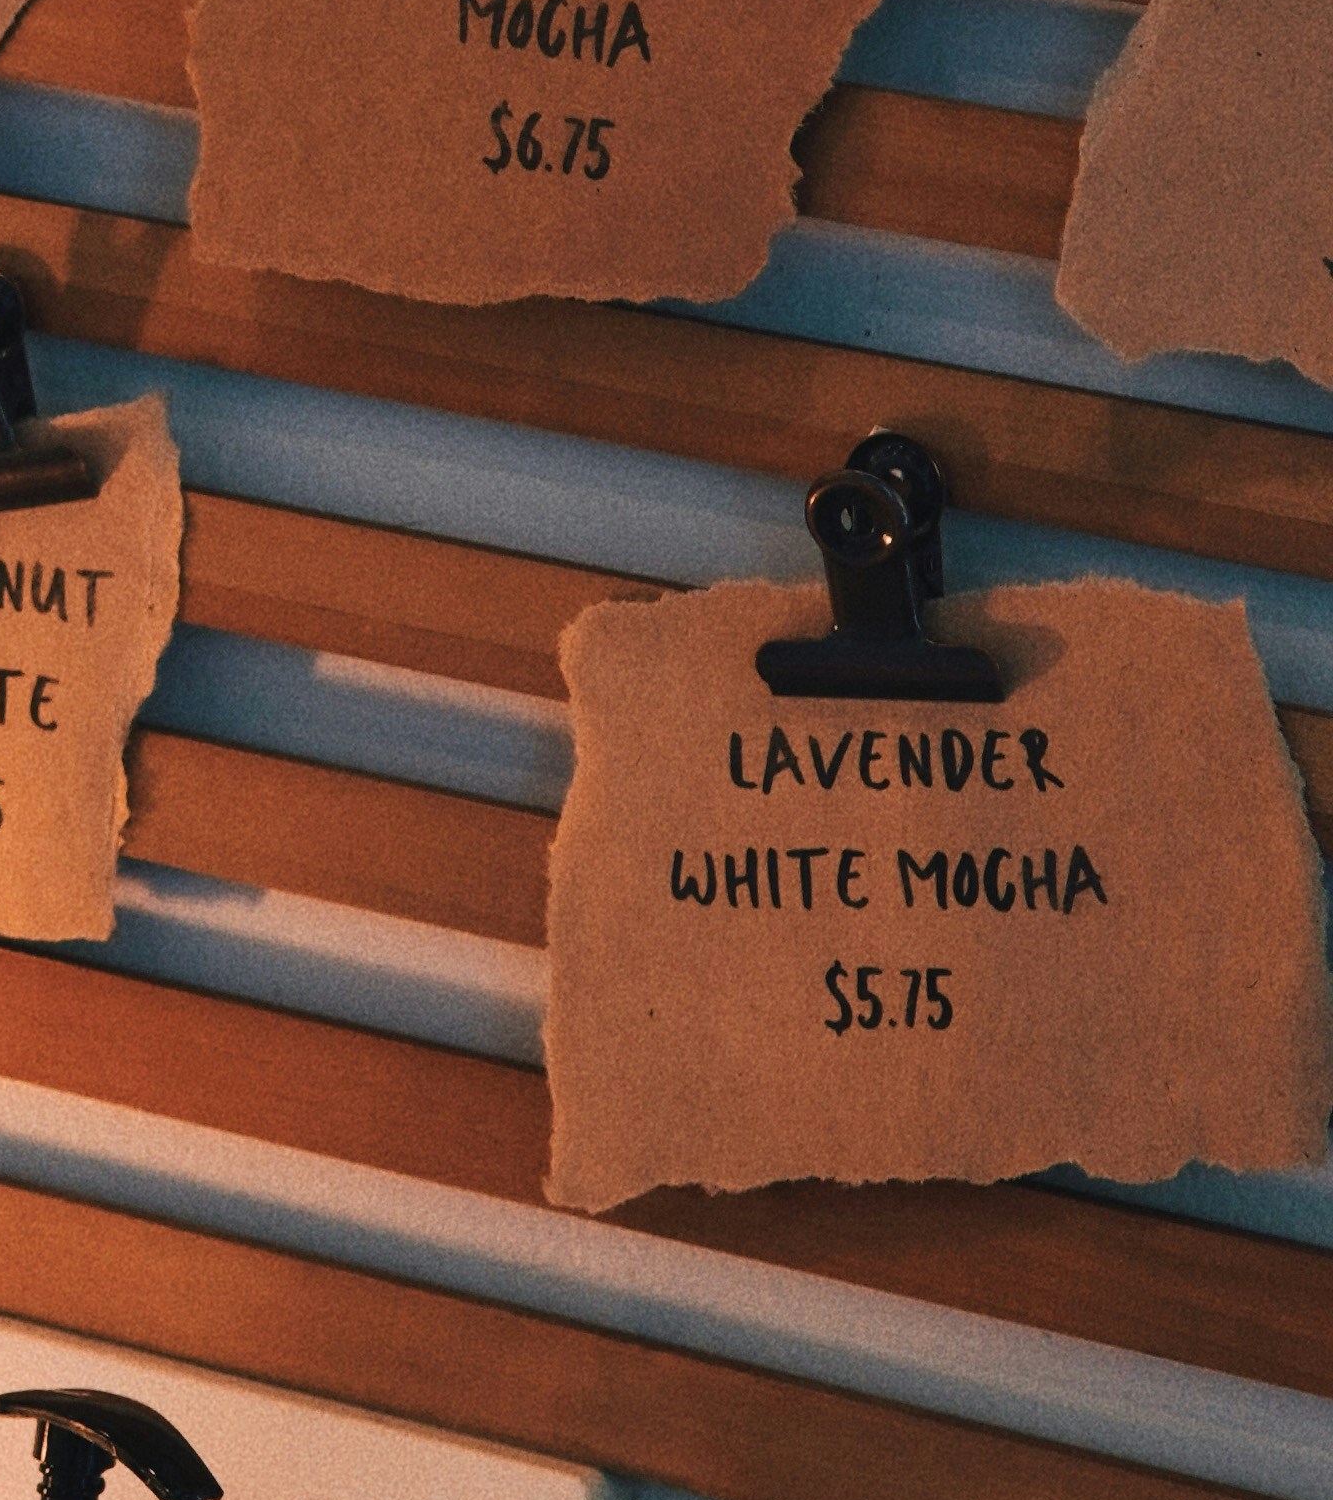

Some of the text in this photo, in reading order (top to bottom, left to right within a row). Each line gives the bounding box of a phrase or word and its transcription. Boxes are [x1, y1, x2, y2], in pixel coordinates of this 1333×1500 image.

[483, 101, 615, 181] $6.75
[729, 727, 1064, 794] LAVENDER
[670, 846, 1107, 915] WHITE MOCHA
[824, 960, 954, 1036] $5.75
